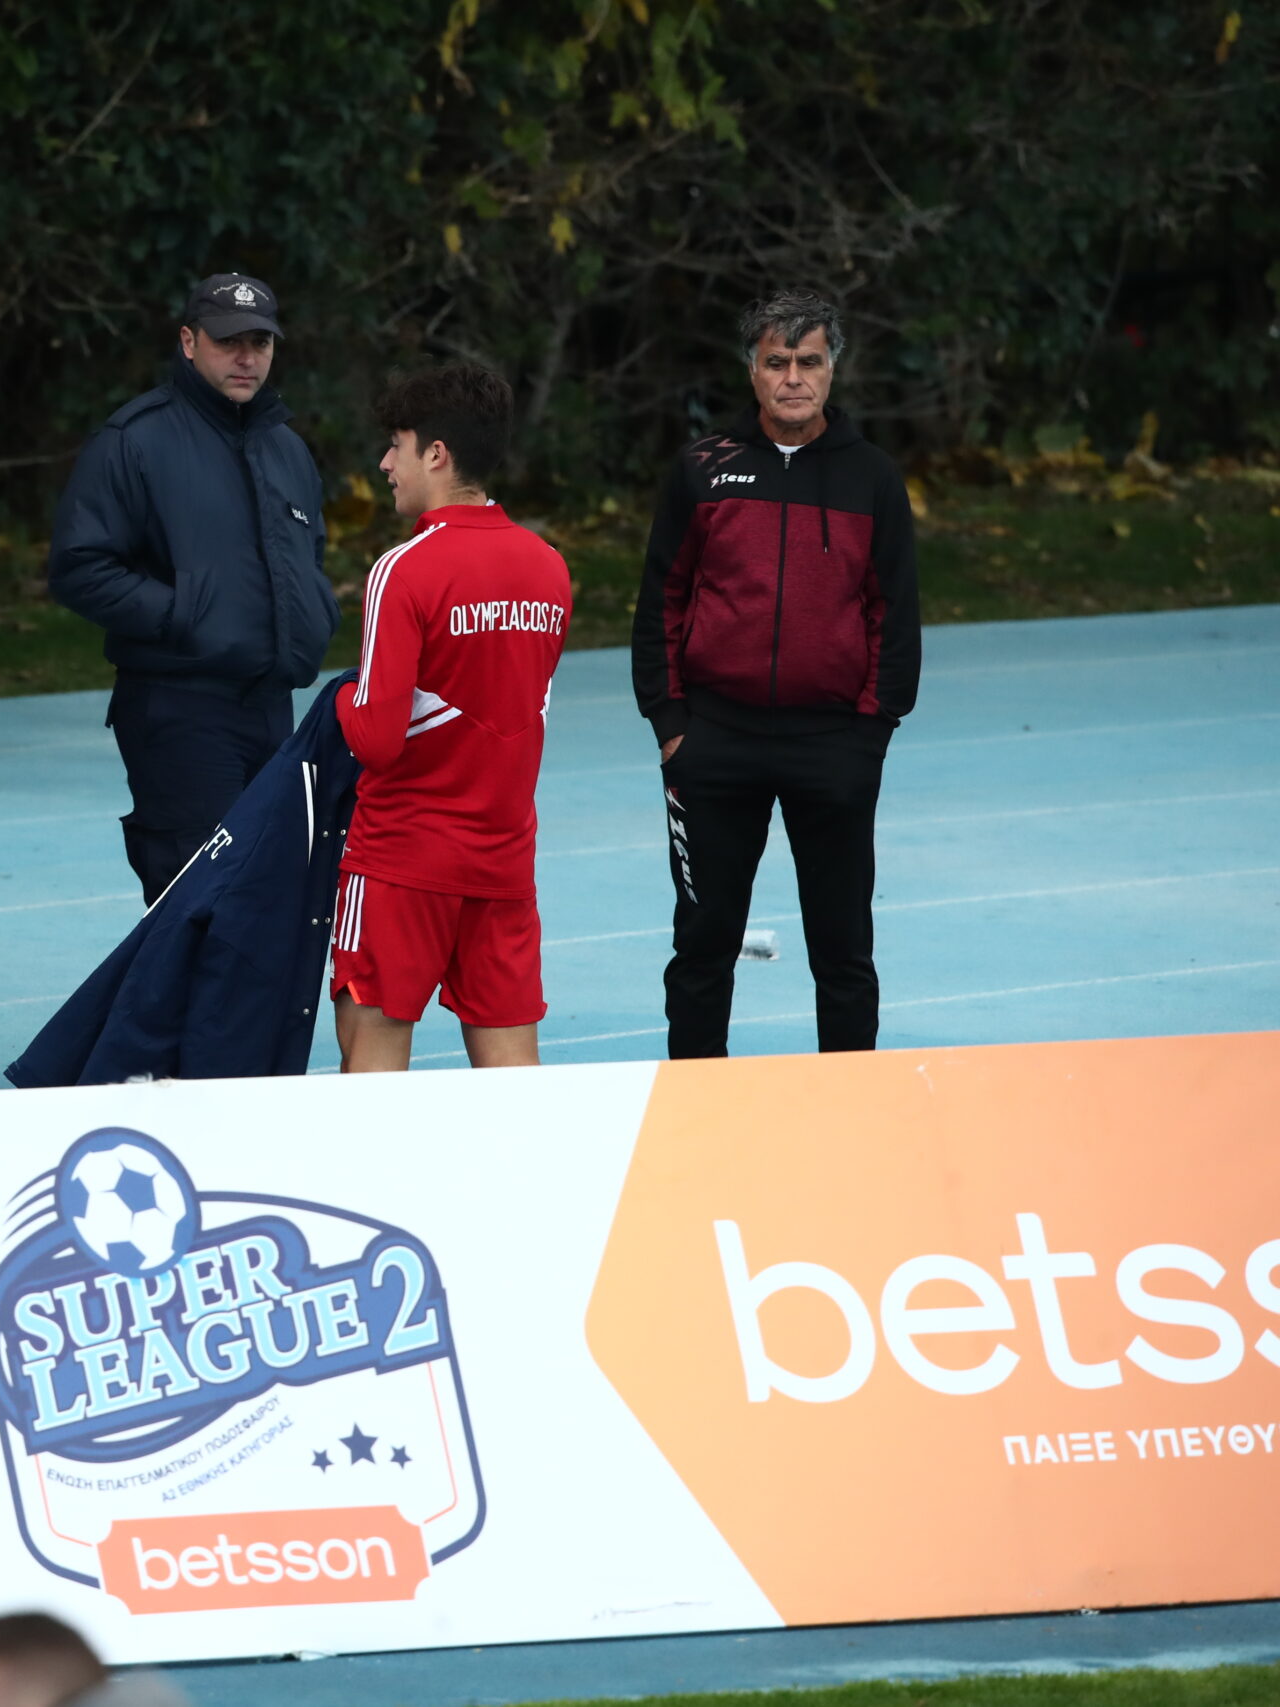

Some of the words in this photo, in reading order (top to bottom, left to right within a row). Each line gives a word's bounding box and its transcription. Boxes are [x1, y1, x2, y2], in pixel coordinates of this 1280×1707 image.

[449, 600, 550, 637] OLYMPIACOS
[549, 603, 565, 636] FC
[205, 827, 233, 861] FC
[13, 1234, 293, 1363] SUPER
[712, 1211, 1280, 1404] bets
[21, 1278, 370, 1432] LEAGUE
[371, 1244, 440, 1358] 2
[177, 1462, 230, 1497] ΕΘΝΙΚΗΣ
[228, 1413, 296, 1469] ΚΑΤΗΓΟΡΙΑΣ
[1002, 1431, 1118, 1466] ΠΑΙΞΕ
[1125, 1423, 1280, 1460] ΥΠΕΥΘΥ
[46, 1467, 94, 1491] ΕΝΩΣΗ
[130, 1533, 397, 1591] betsson
